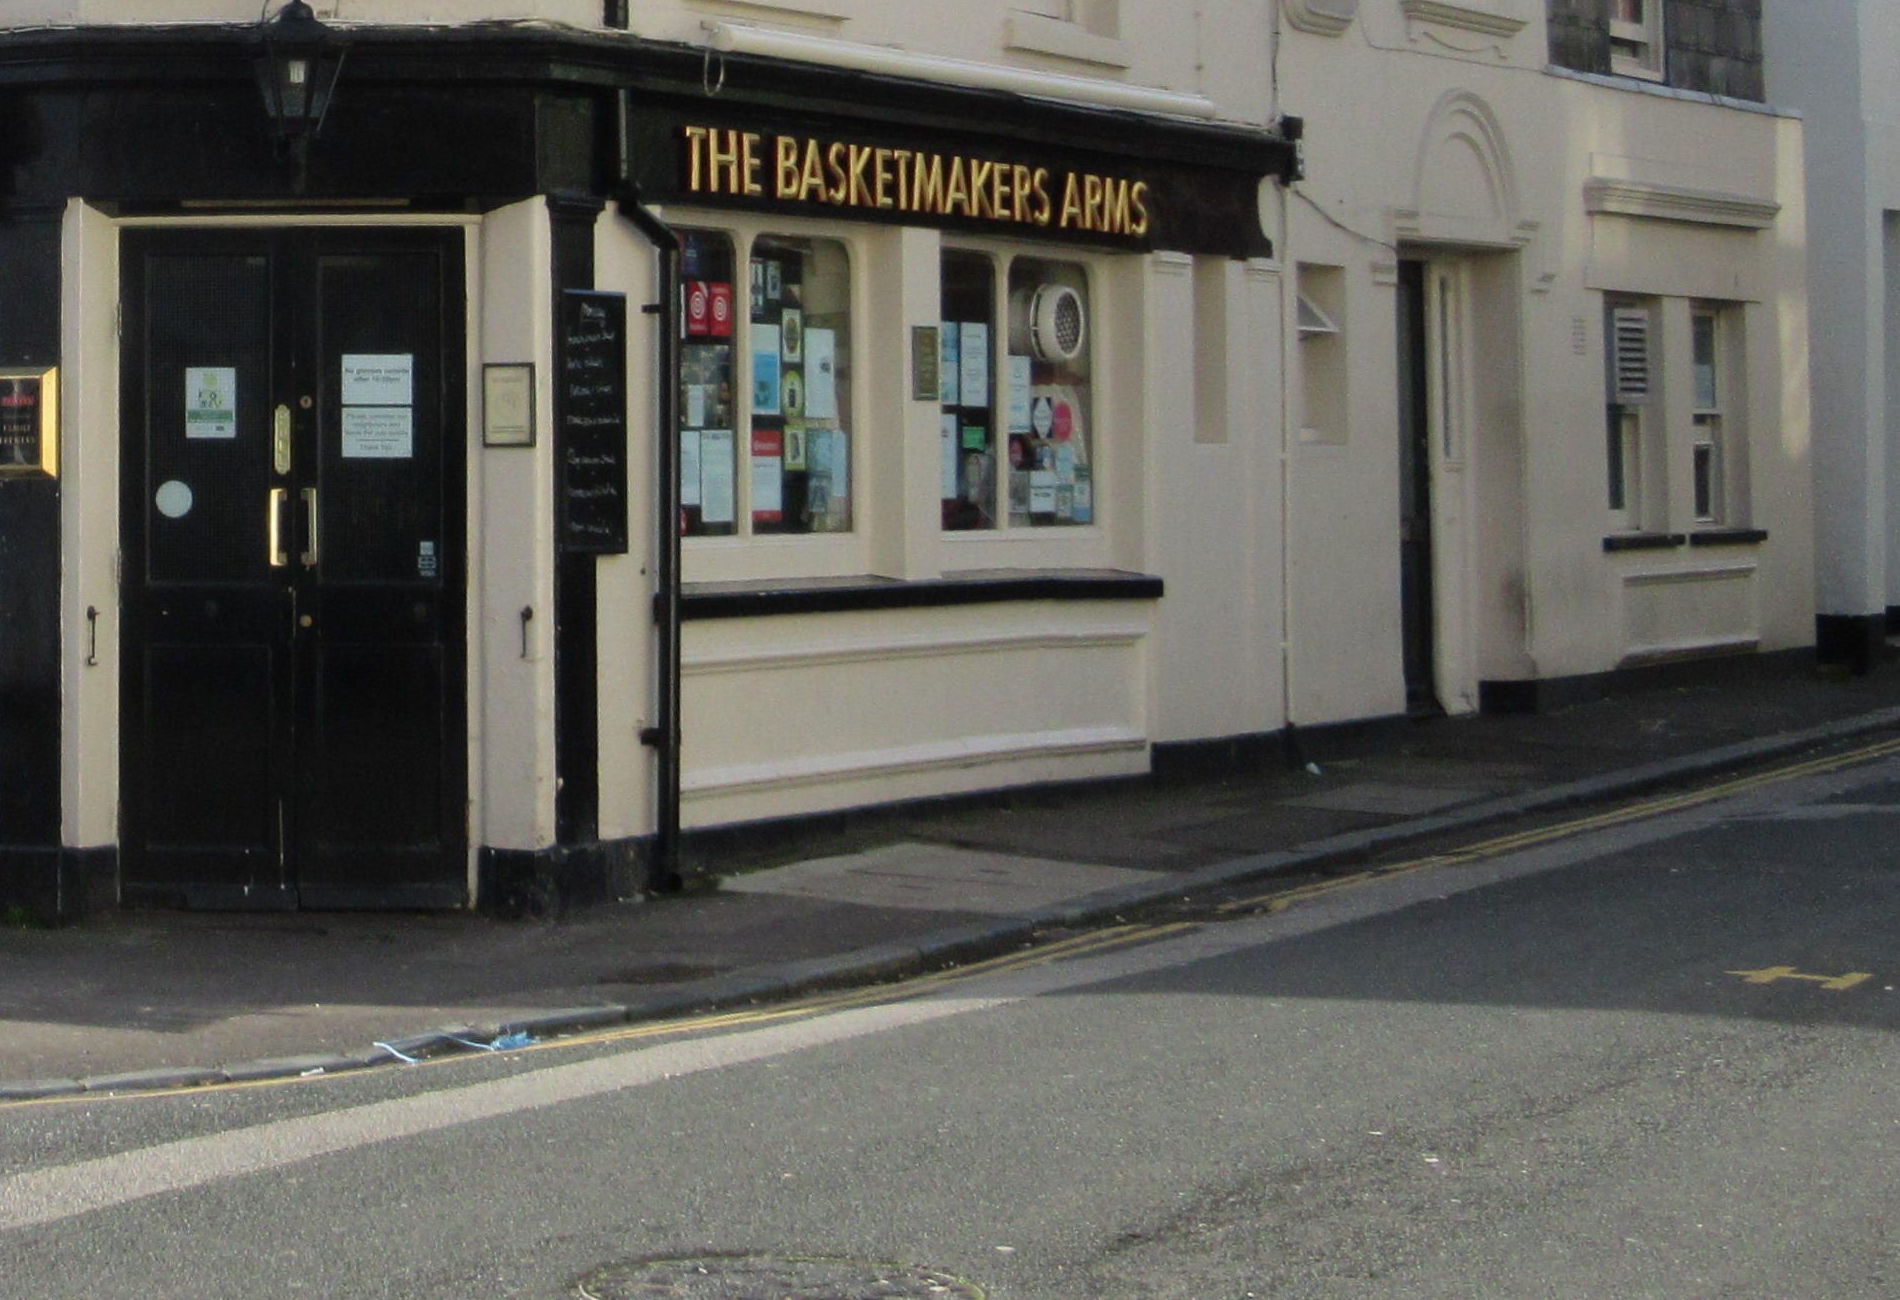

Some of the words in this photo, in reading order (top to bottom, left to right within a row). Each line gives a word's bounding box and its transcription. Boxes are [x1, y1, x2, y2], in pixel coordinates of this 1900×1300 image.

[684, 125, 763, 197] THE
[775, 134, 1052, 228] BASKETMAKERS
[1060, 171, 1149, 238] ARMS
